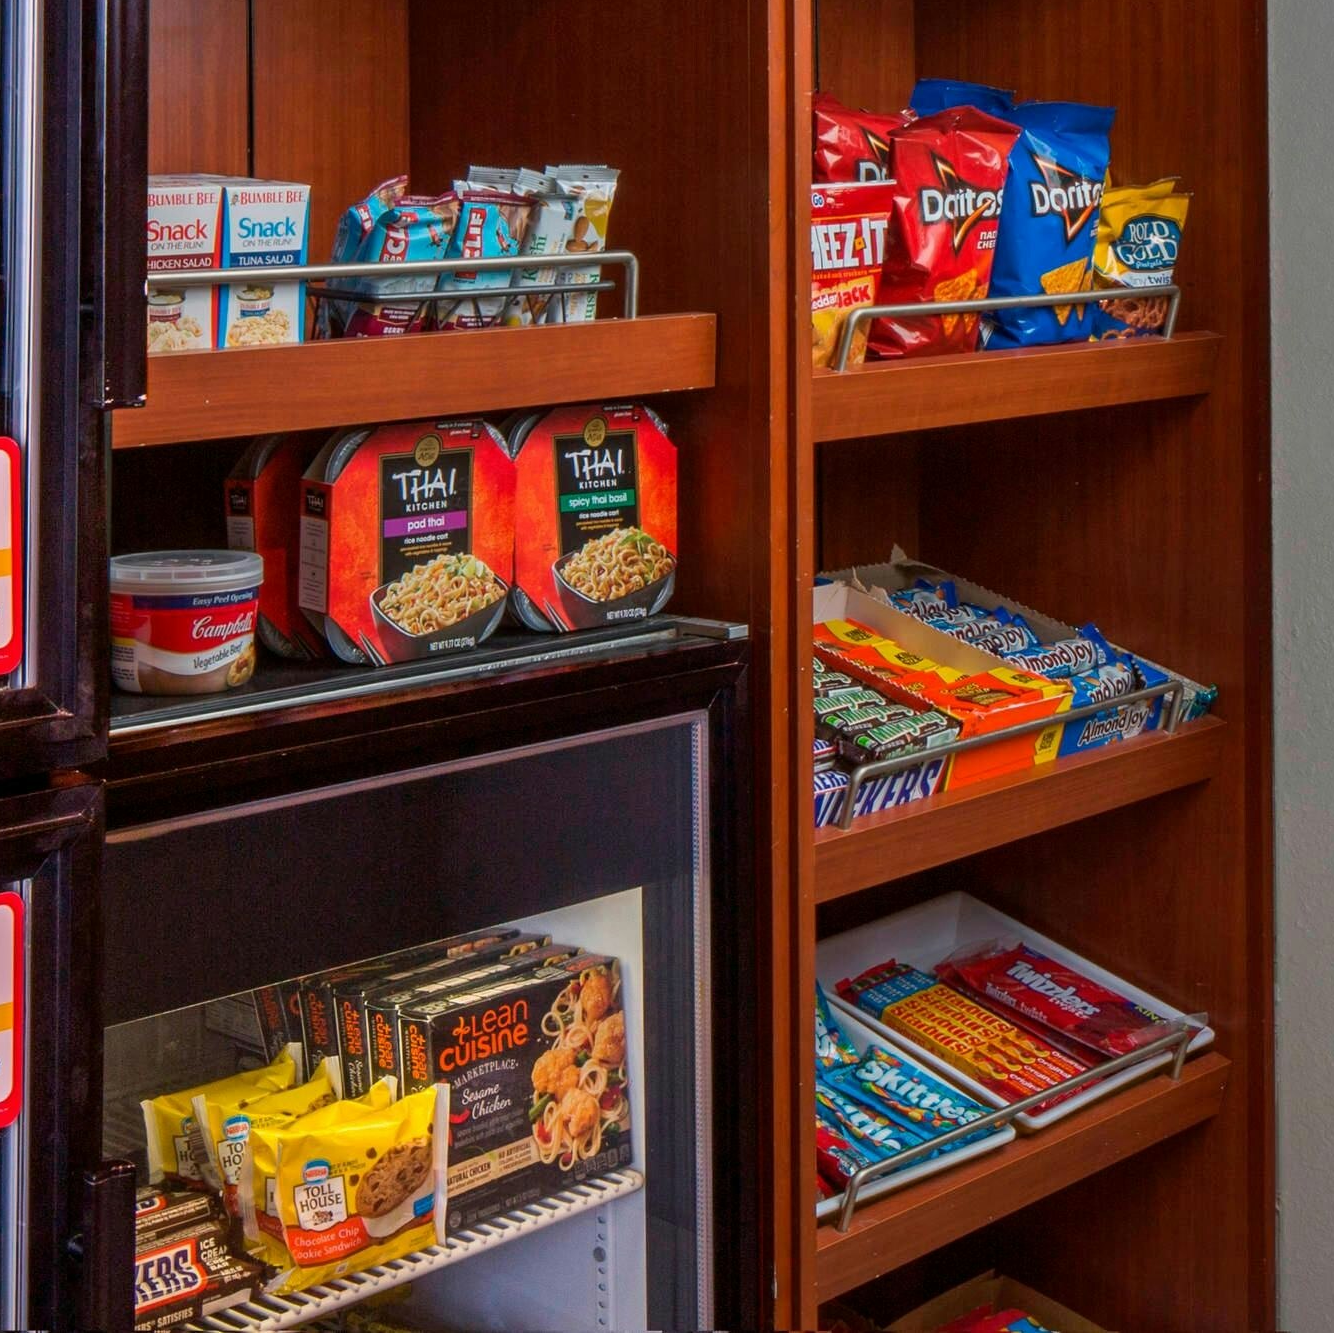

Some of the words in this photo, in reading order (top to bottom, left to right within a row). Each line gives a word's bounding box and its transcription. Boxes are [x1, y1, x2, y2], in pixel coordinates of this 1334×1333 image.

[148, 192, 194, 207] BUMBLE
[240, 191, 284, 205] BUMBLE
[1031, 180, 1104, 215] Dorito
[147, 218, 208, 242] Snack
[238, 217, 296, 239] Snack
[1128, 221, 1169, 244] ROLD
[184, 257, 212, 267] SALAD
[239, 256, 263, 266] TUNA
[266, 254, 294, 264] SALAD
[1117, 239, 1178, 265] GOLD
[383, 326, 405, 334] BERRY
[564, 449, 625, 480] THAI
[392, 467, 457, 502] THAI
[579, 479, 617, 489] KITCHEN
[405, 501, 448, 513] KITCHEN
[569, 496, 590, 508] spicy
[592, 494, 608, 505] thai
[609, 492, 628, 503] basil
[407, 518, 426, 532] pad
[427, 516, 445, 527] thai
[192, 597, 212, 607] Easy
[213, 595, 230, 604] Peel
[231, 591, 253, 603] Opening
[193, 648, 229, 671] Vegetable
[229, 641, 243, 656] Beef
[1079, 716, 1126, 747] Almond
[1125, 706, 1148, 731] Joy
[1006, 960, 1101, 1016] Twizzlers
[472, 999, 528, 1038] Lean
[454, 1058, 516, 1090] MARKETPLACE
[461, 1083, 500, 1106] Sesame
[855, 1060, 982, 1125] Skittles
[472, 1095, 512, 1120] Chicken
[299, 1193, 343, 1212] HOUSE
[303, 1183, 335, 1200] TOLL
[199, 1237, 215, 1252] ICE
[293, 1230, 336, 1248] Chocolate
[338, 1226, 361, 1240] Chip
[323, 1237, 363, 1256] Sandwich
[157, 1307, 194, 1328] SATISFIES
